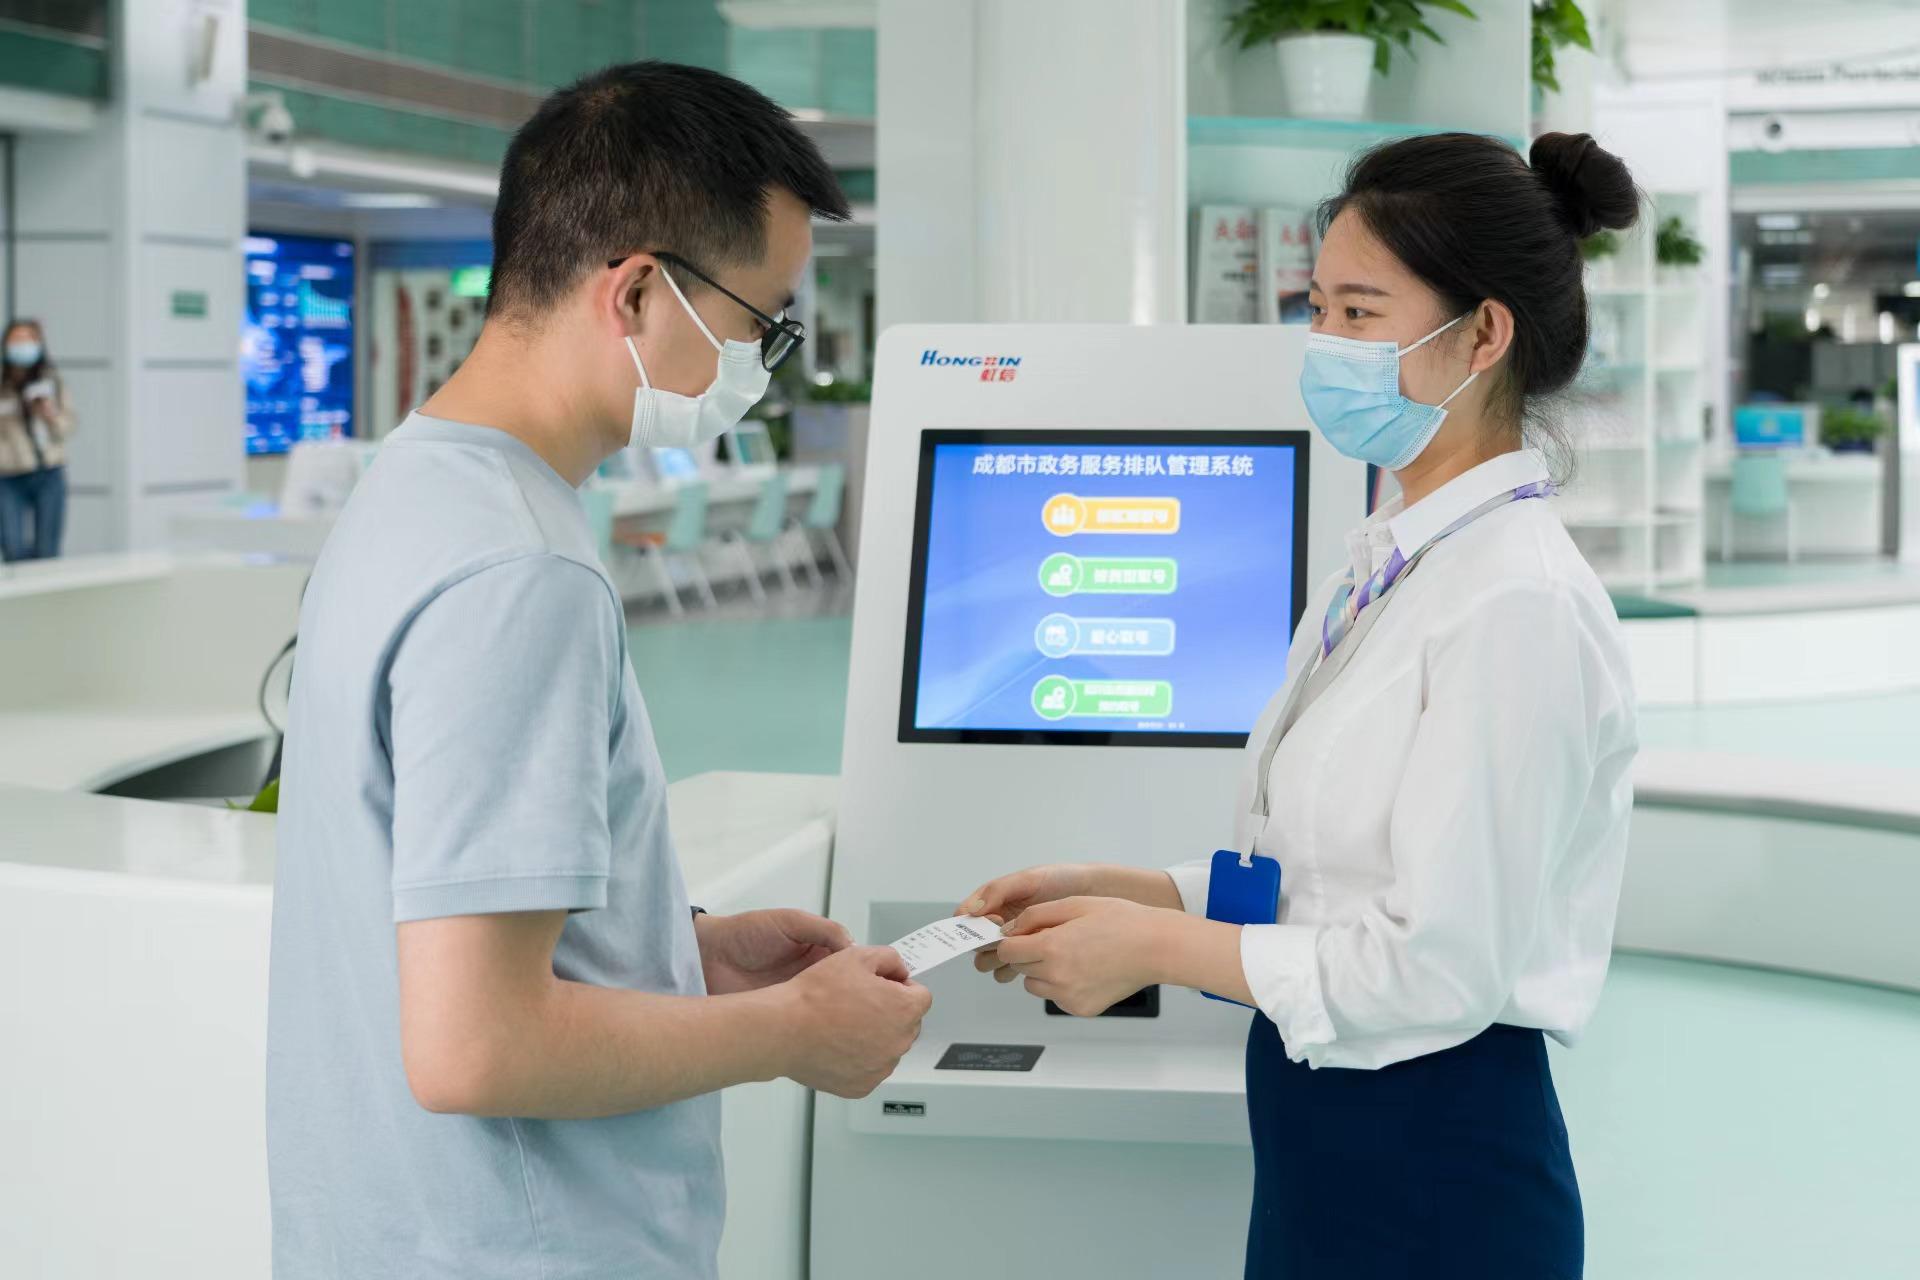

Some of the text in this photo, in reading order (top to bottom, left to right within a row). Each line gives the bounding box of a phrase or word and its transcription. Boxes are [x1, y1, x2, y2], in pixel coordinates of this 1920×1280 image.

[972, 454, 1255, 477] 成都市政务服务排队管理系统
